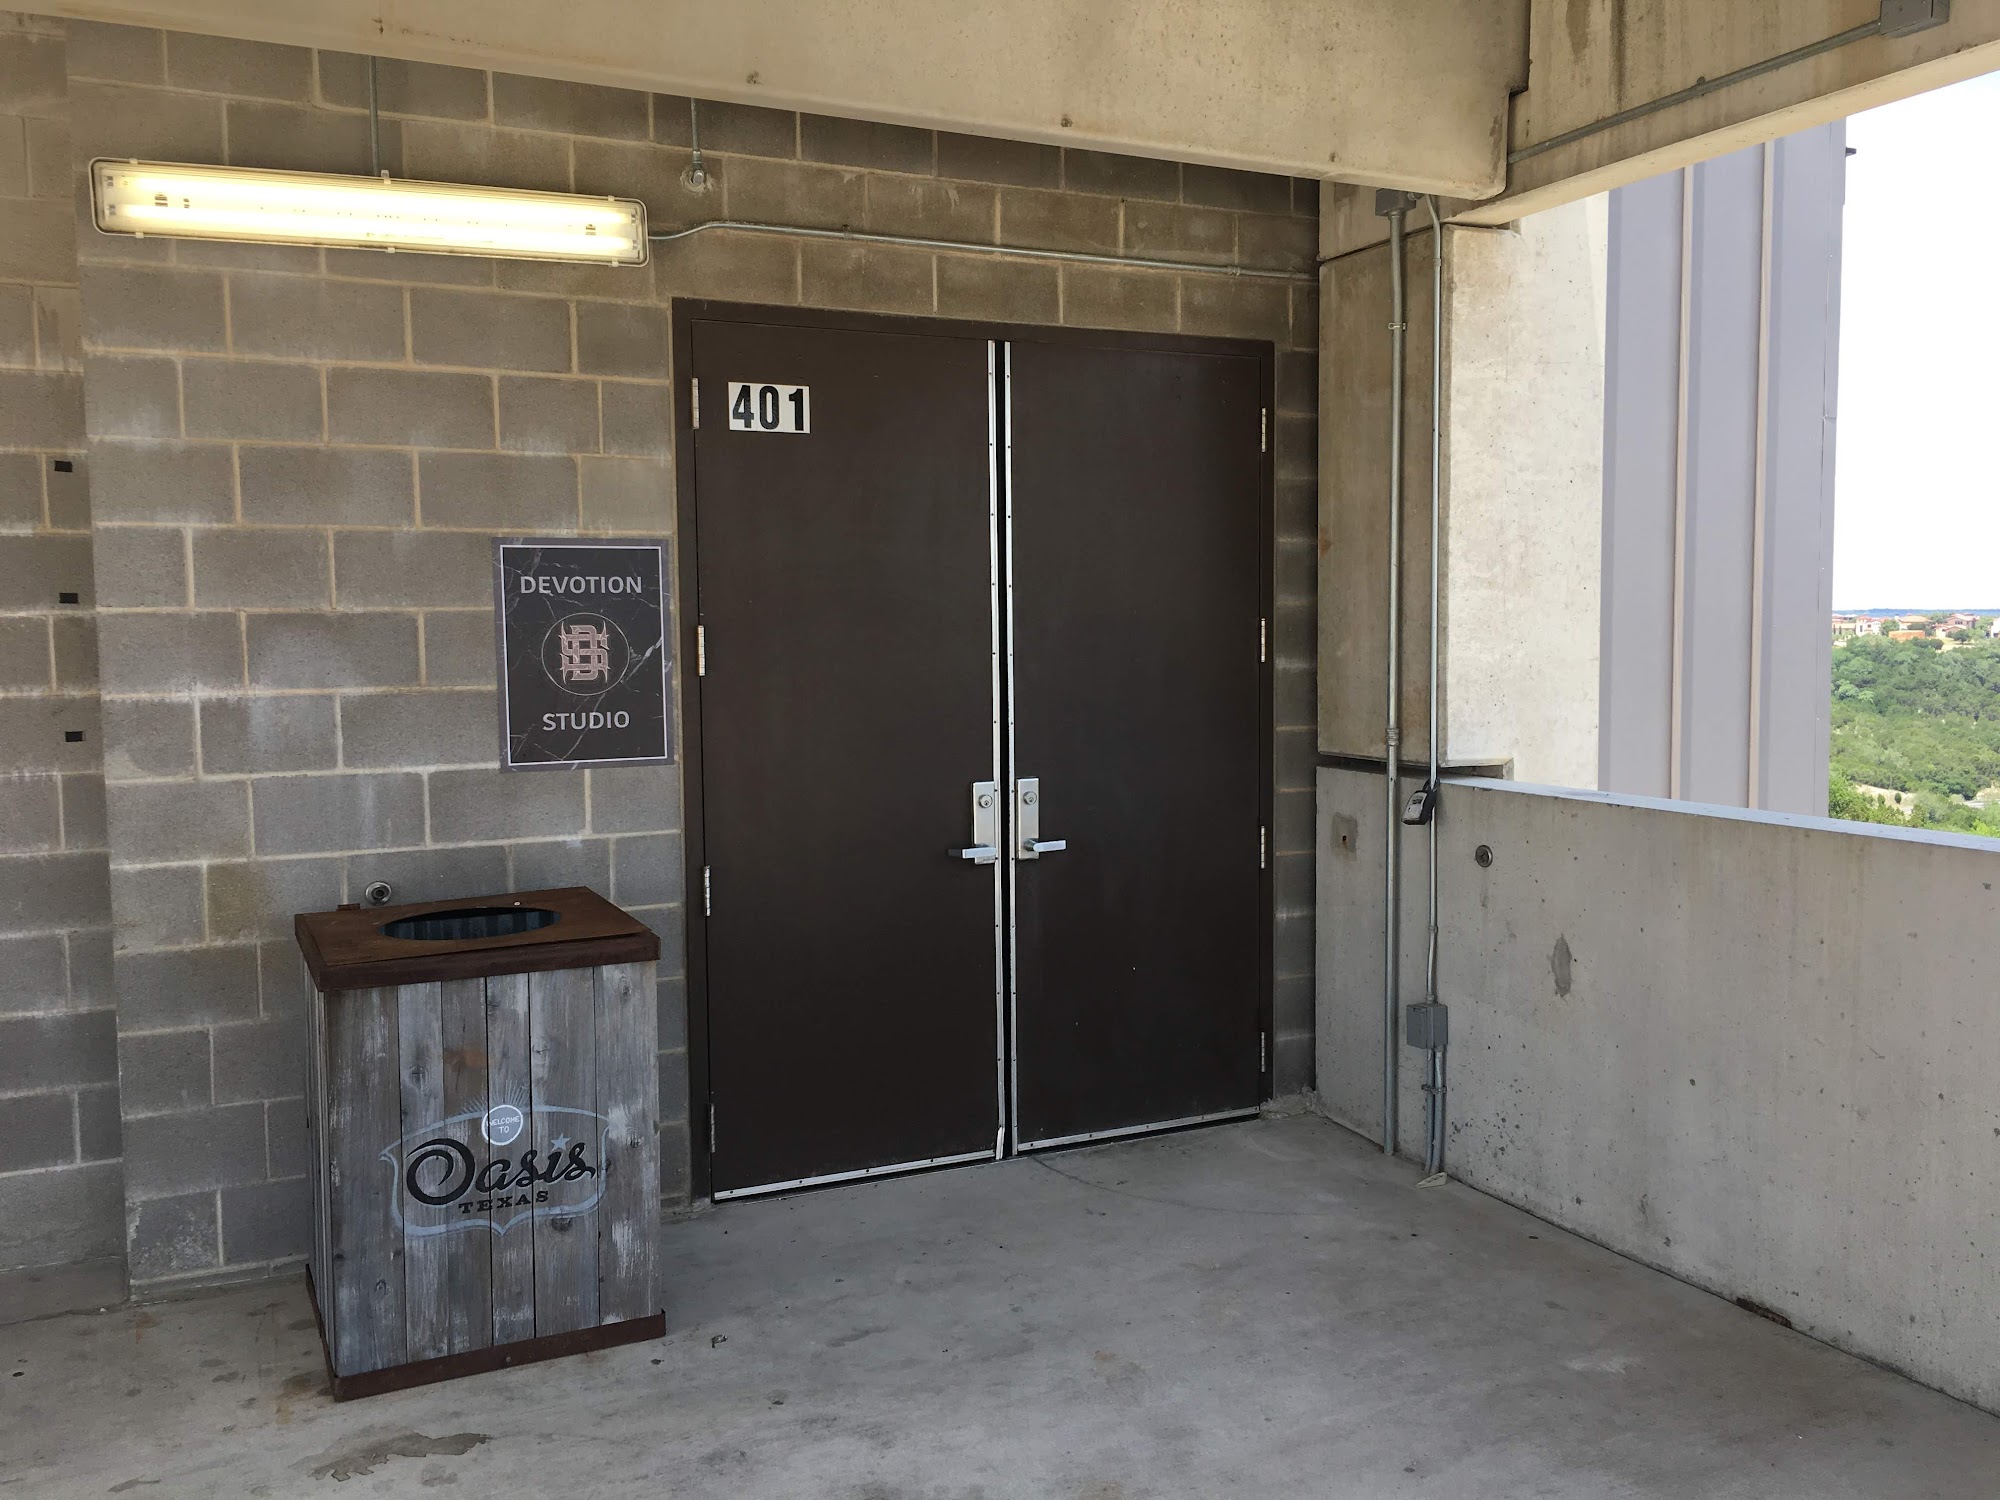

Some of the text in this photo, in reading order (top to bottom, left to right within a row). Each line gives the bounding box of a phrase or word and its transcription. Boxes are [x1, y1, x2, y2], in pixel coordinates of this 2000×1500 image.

[733, 385, 804, 431] 401
[520, 576, 642, 594] DEVOTION
[542, 710, 630, 731] STUDIO
[486, 1115, 520, 1127] WELCOME
[498, 1126, 510, 1134] TO
[405, 1138, 596, 1205] Oasis
[459, 1190, 549, 1214] TEXAS
